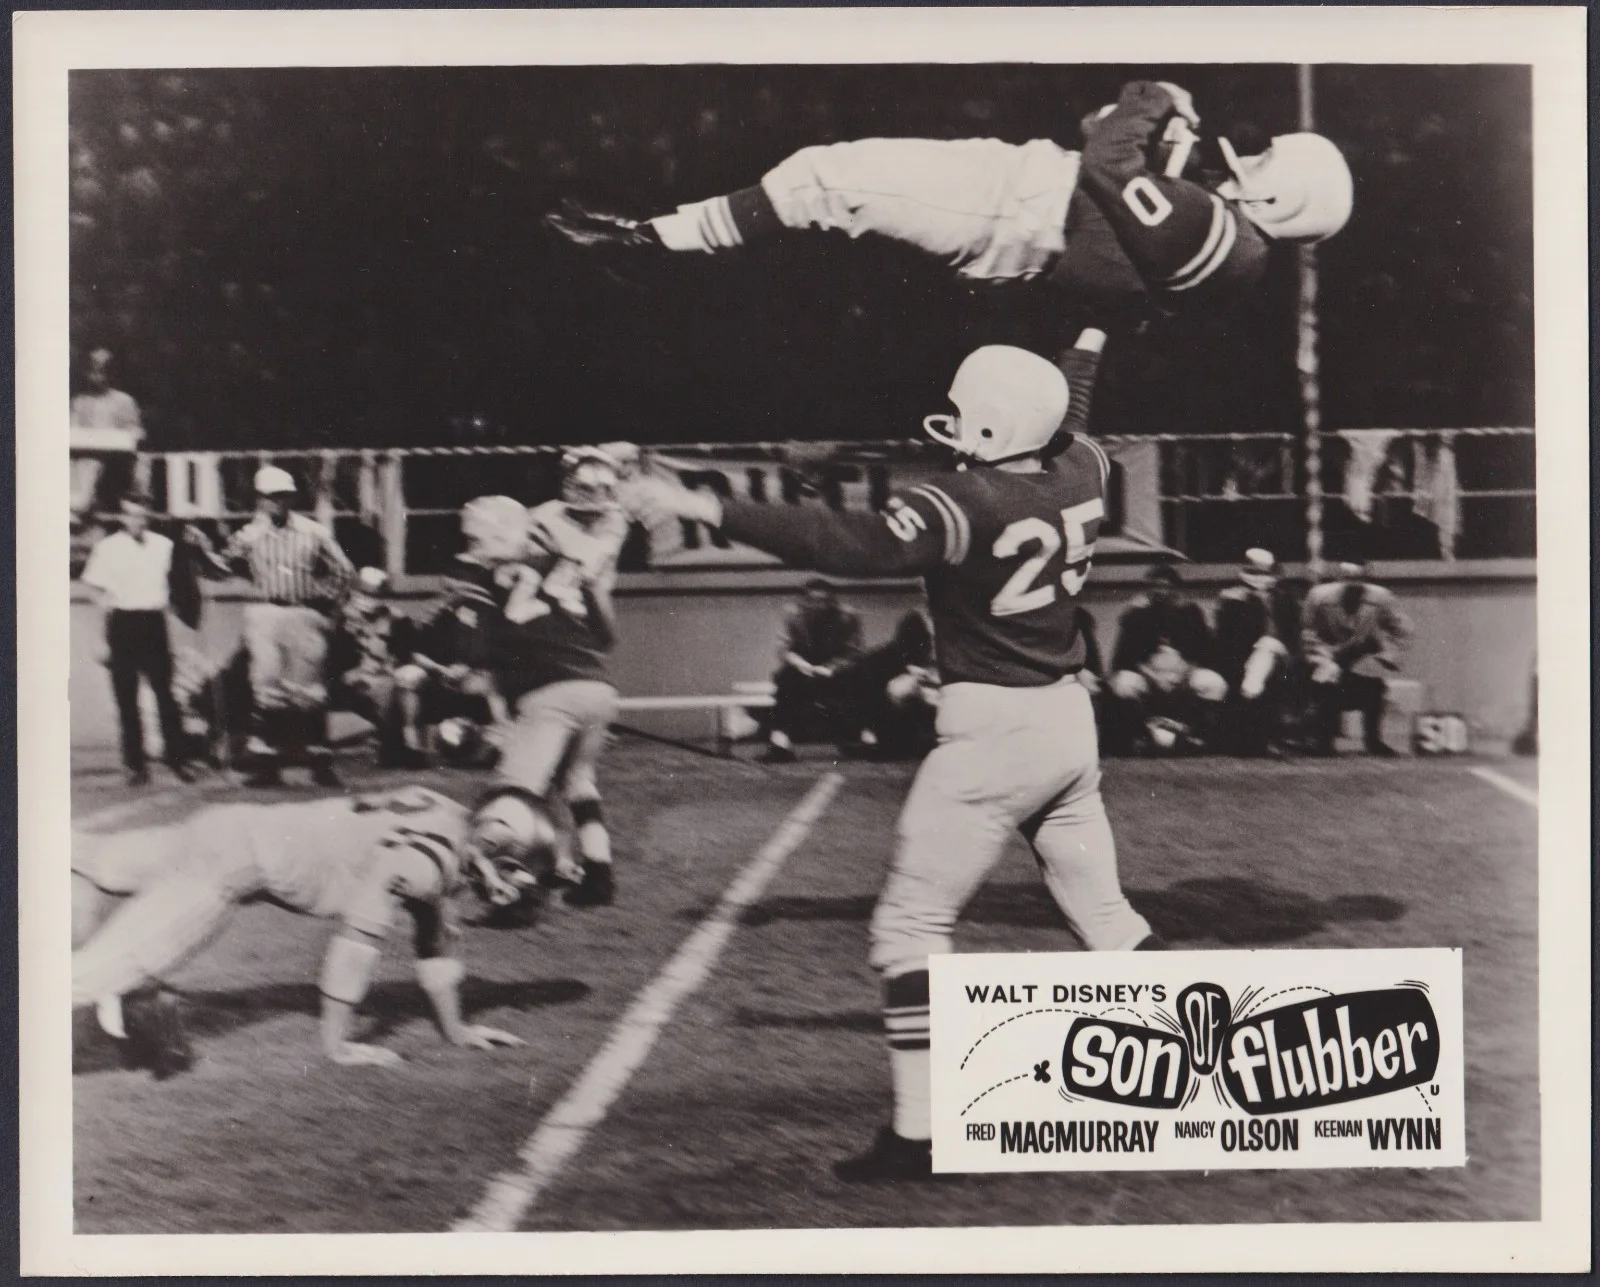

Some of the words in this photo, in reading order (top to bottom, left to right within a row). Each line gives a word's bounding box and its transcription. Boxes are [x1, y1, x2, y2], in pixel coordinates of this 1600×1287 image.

[990, 498, 1104, 616] 25
[964, 985, 1038, 1003] WALT
[1053, 984, 1167, 1003] DISNEY'S
[1185, 991, 1221, 1066] OF
[1227, 1005, 1428, 1102] flubber
[966, 1123, 996, 1141] FRED
[1000, 1120, 1160, 1153] MACMURRAY
[1174, 1120, 1216, 1139] NANCY
[1220, 1118, 1299, 1152] OLSON
[1314, 1119, 1363, 1138] KEENAN
[1366, 1117, 1442, 1151] WYNN
